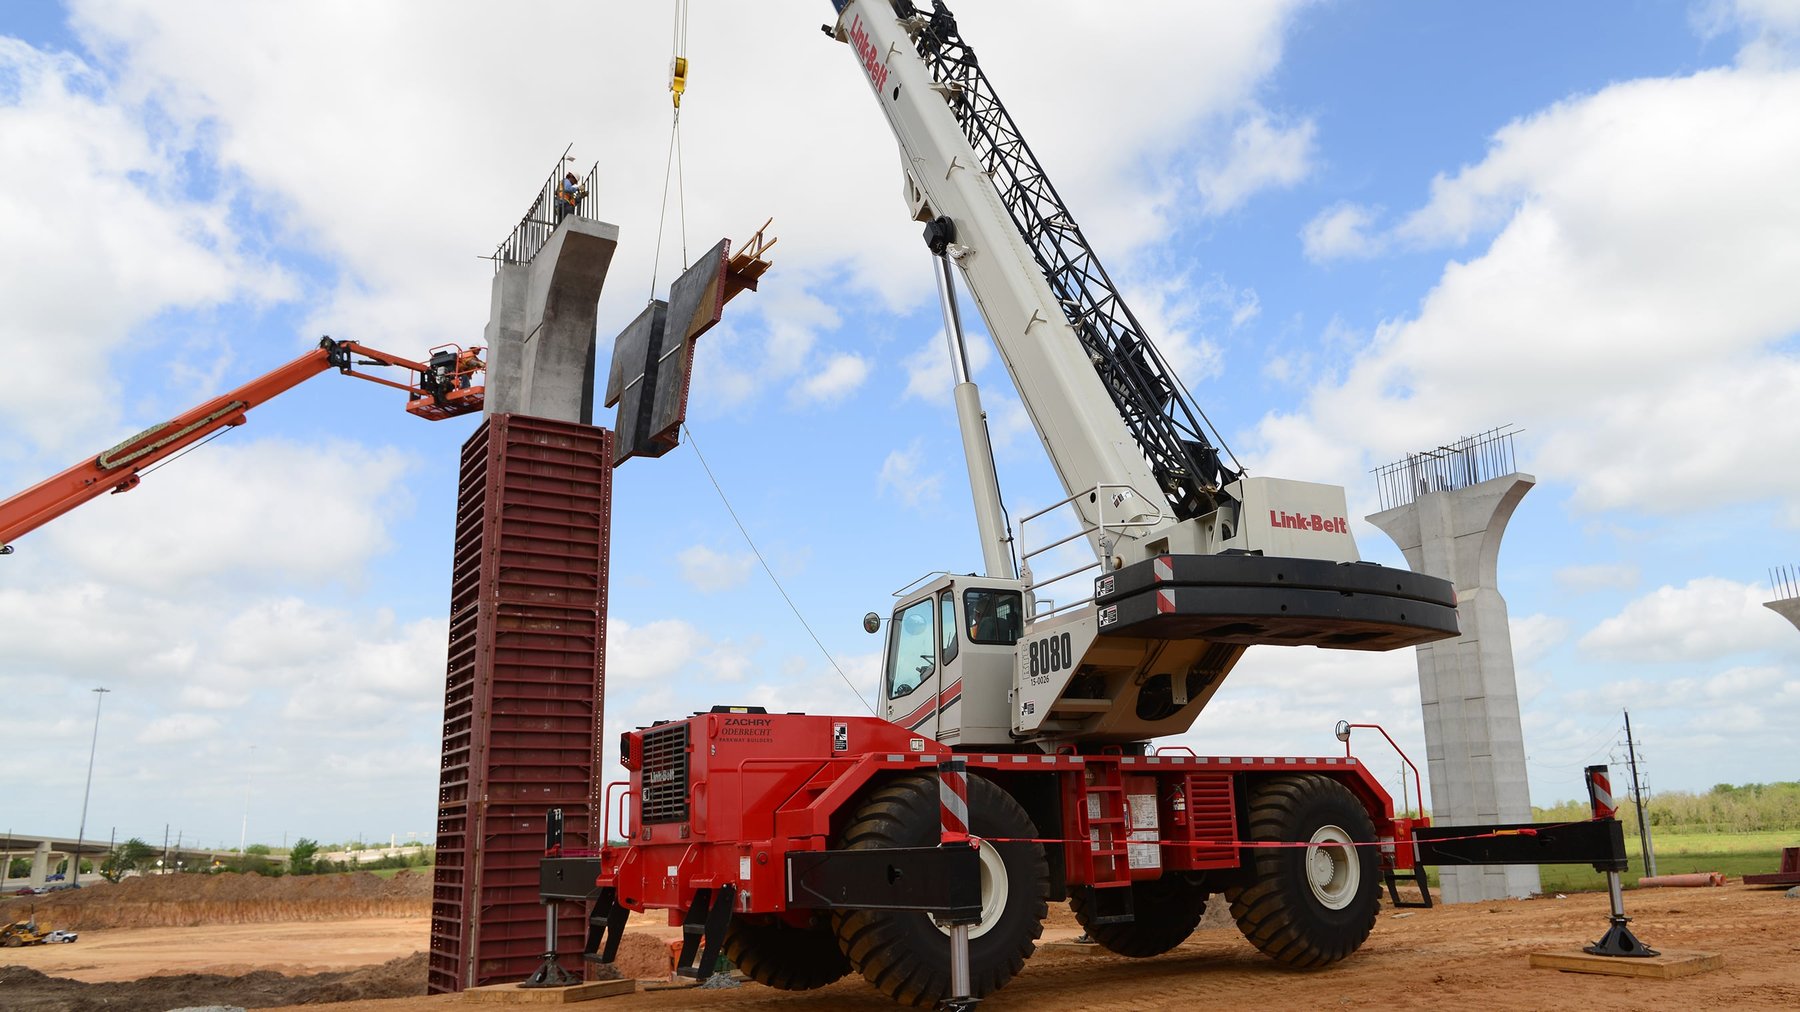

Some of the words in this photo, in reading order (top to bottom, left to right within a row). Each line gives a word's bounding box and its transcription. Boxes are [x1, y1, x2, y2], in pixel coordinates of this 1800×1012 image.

[850, 13, 888, 94] Link-Belt
[1270, 510, 1347, 534] Link-Belt
[1029, 632, 1072, 677] 8080
[1030, 675, 1050, 686] 15-0026
[725, 718, 772, 726] ZACHRY
[721, 728, 772, 736] ODEBRECHT
